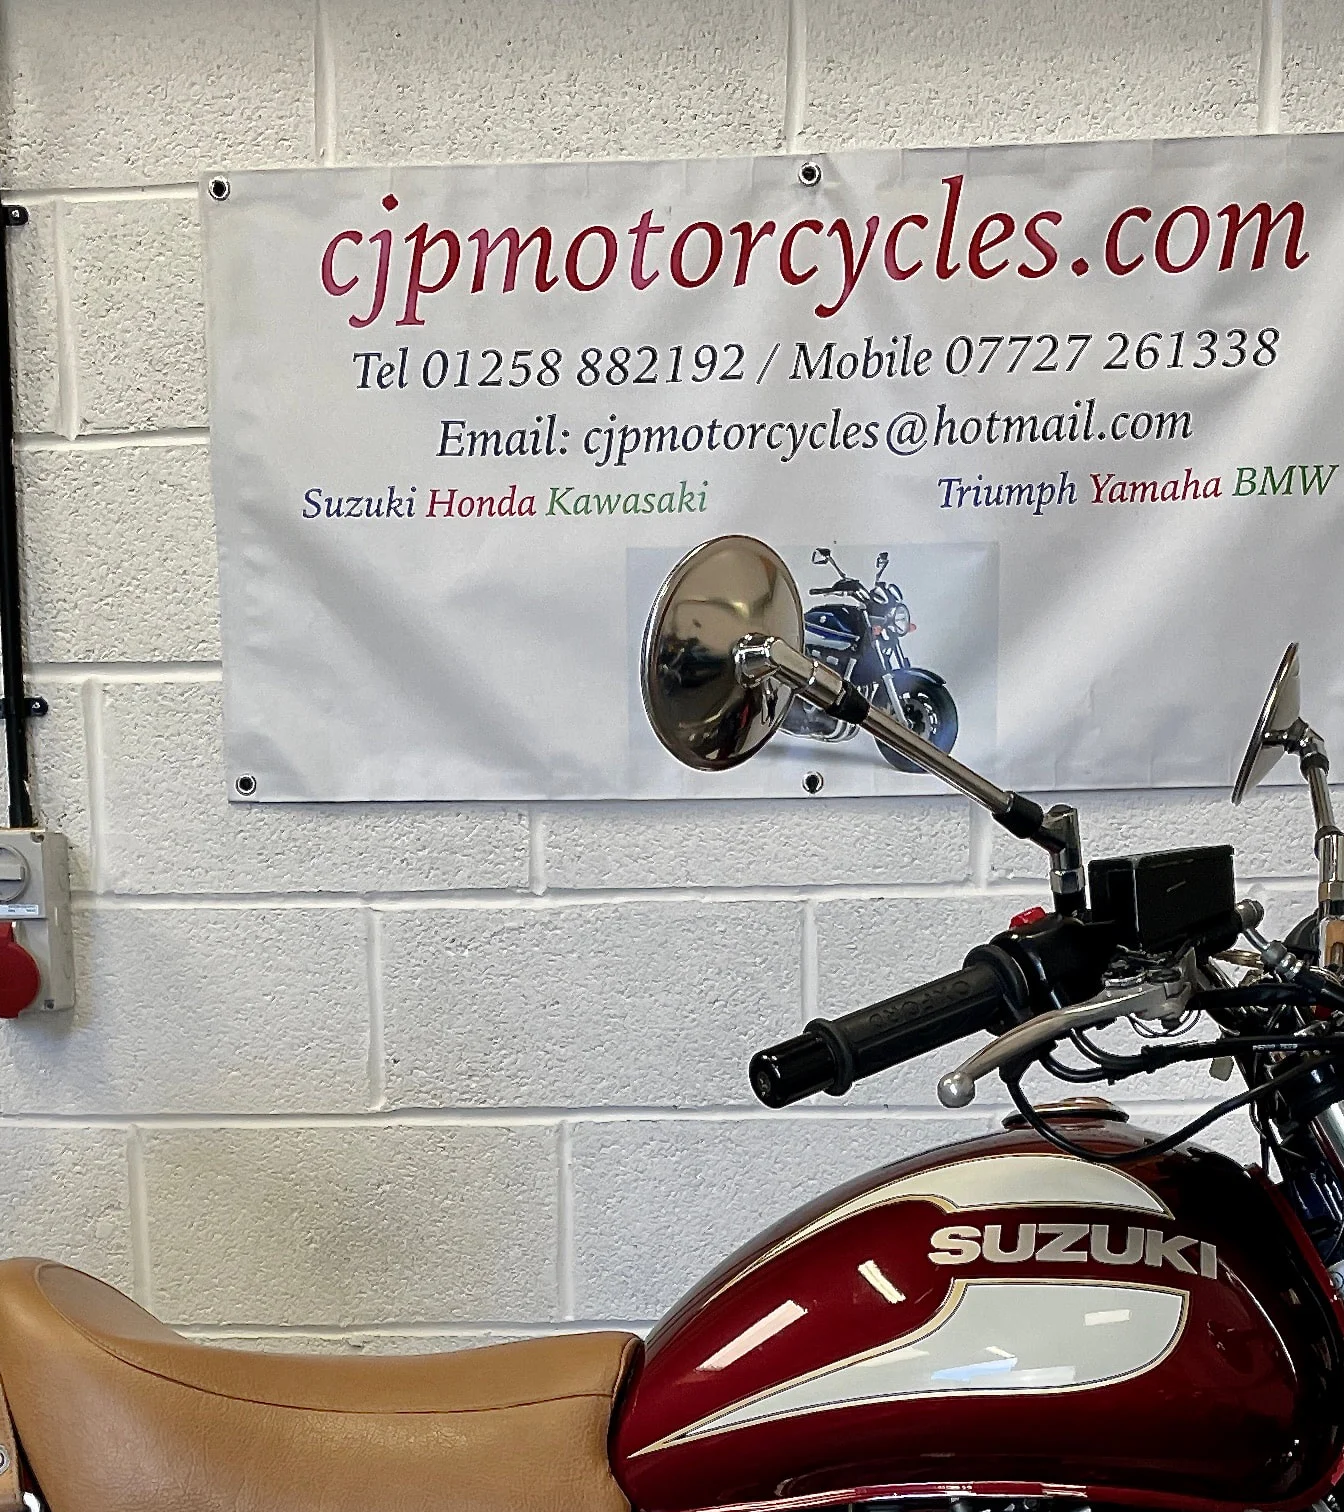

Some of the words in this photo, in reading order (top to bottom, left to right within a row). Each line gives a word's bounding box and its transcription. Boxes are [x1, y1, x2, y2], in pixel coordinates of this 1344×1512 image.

[321, 174, 1310, 328] cjpmotorcycles.com
[353, 347, 408, 389] Tel
[423, 349, 562, 388] 01258
[577, 344, 744, 386] 882192
[756, 343, 780, 384] /
[789, 334, 932, 379] Mobile
[946, 335, 1092, 374] 07727
[1103, 328, 1279, 369] 261338
[436, 414, 569, 456] Email:
[584, 398, 1192, 467] cjpmotorcycles@hotmail.com
[303, 486, 416, 518] Suzuki
[426, 485, 536, 517] Honda
[545, 481, 708, 516] Kawasaki
[938, 471, 1077, 515] Triumph
[1090, 468, 1222, 503] Yamaha
[1232, 465, 1339, 496] BMW
[928, 1223, 1217, 1280] SUZUKI
